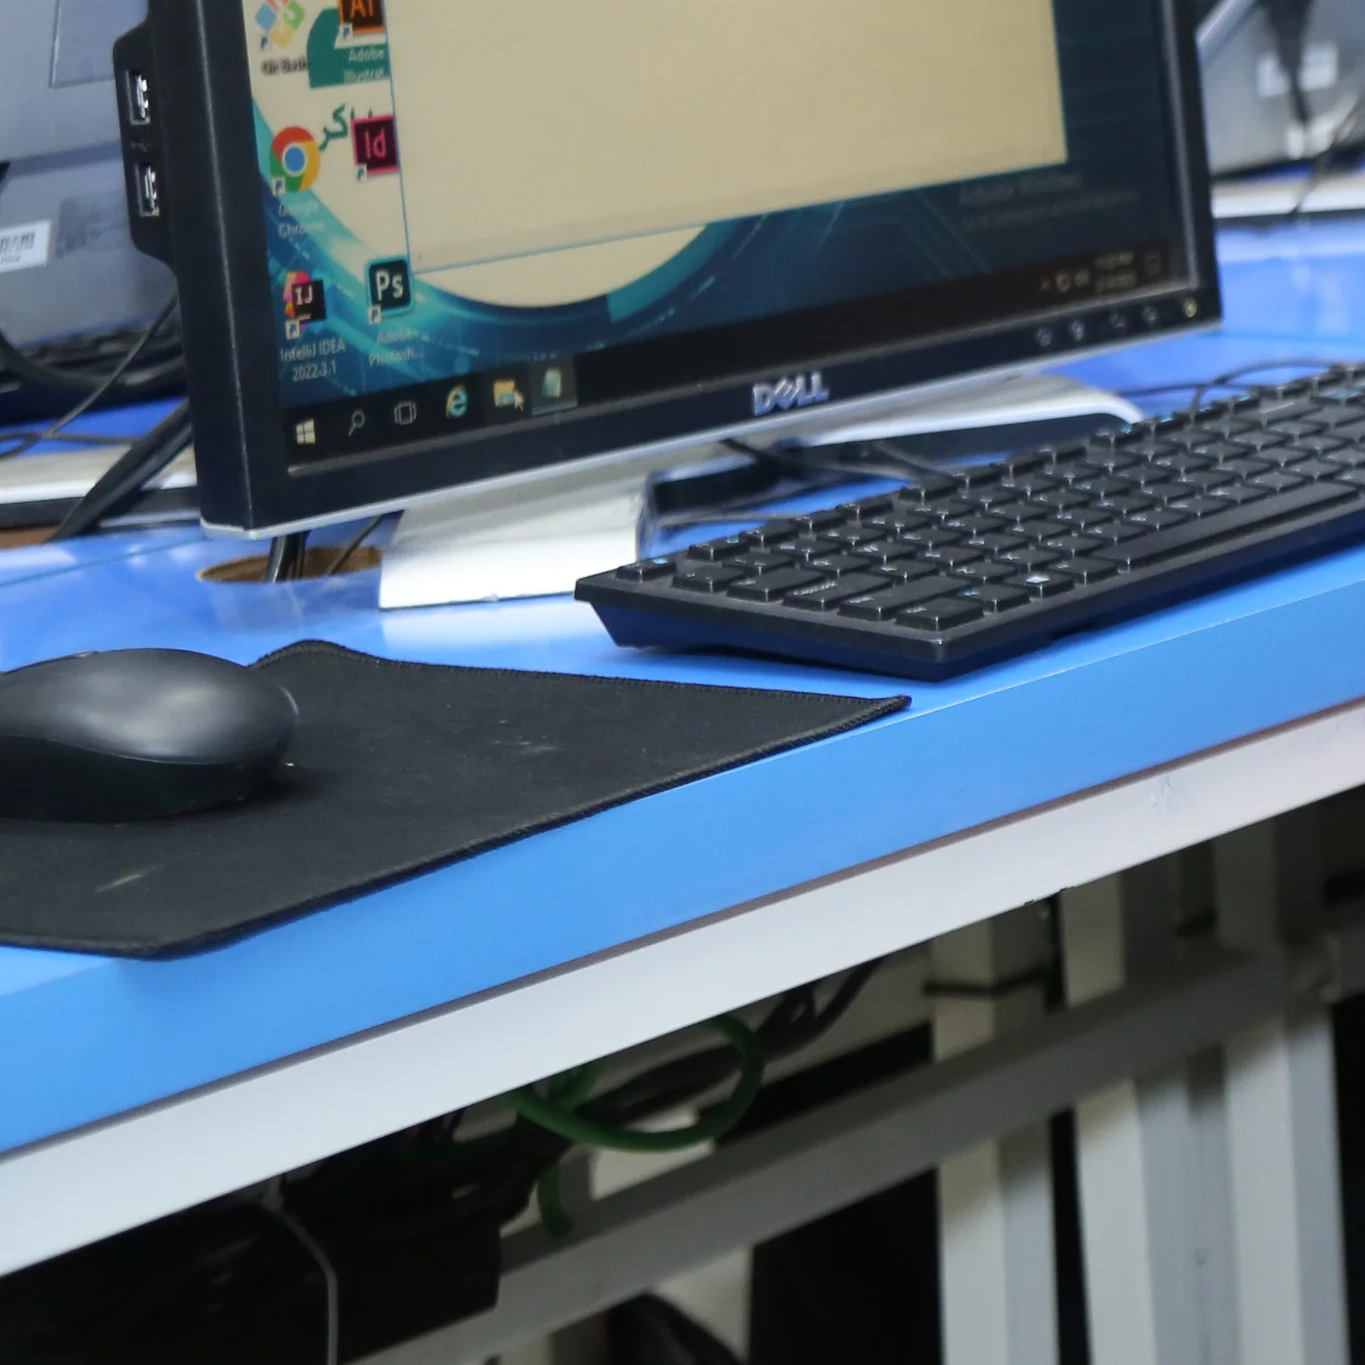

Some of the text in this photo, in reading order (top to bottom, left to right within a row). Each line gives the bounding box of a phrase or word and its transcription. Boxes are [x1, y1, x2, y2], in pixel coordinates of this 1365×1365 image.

[349, 48, 384, 63] Adobe
[365, 128, 388, 160] Id
[295, 286, 313, 306] IJ
[375, 270, 405, 301] Ps
[280, 338, 347, 363] IntelliJ IDEA
[292, 360, 337, 382] 2022.3.1
[752, 371, 830, 417] DELL
